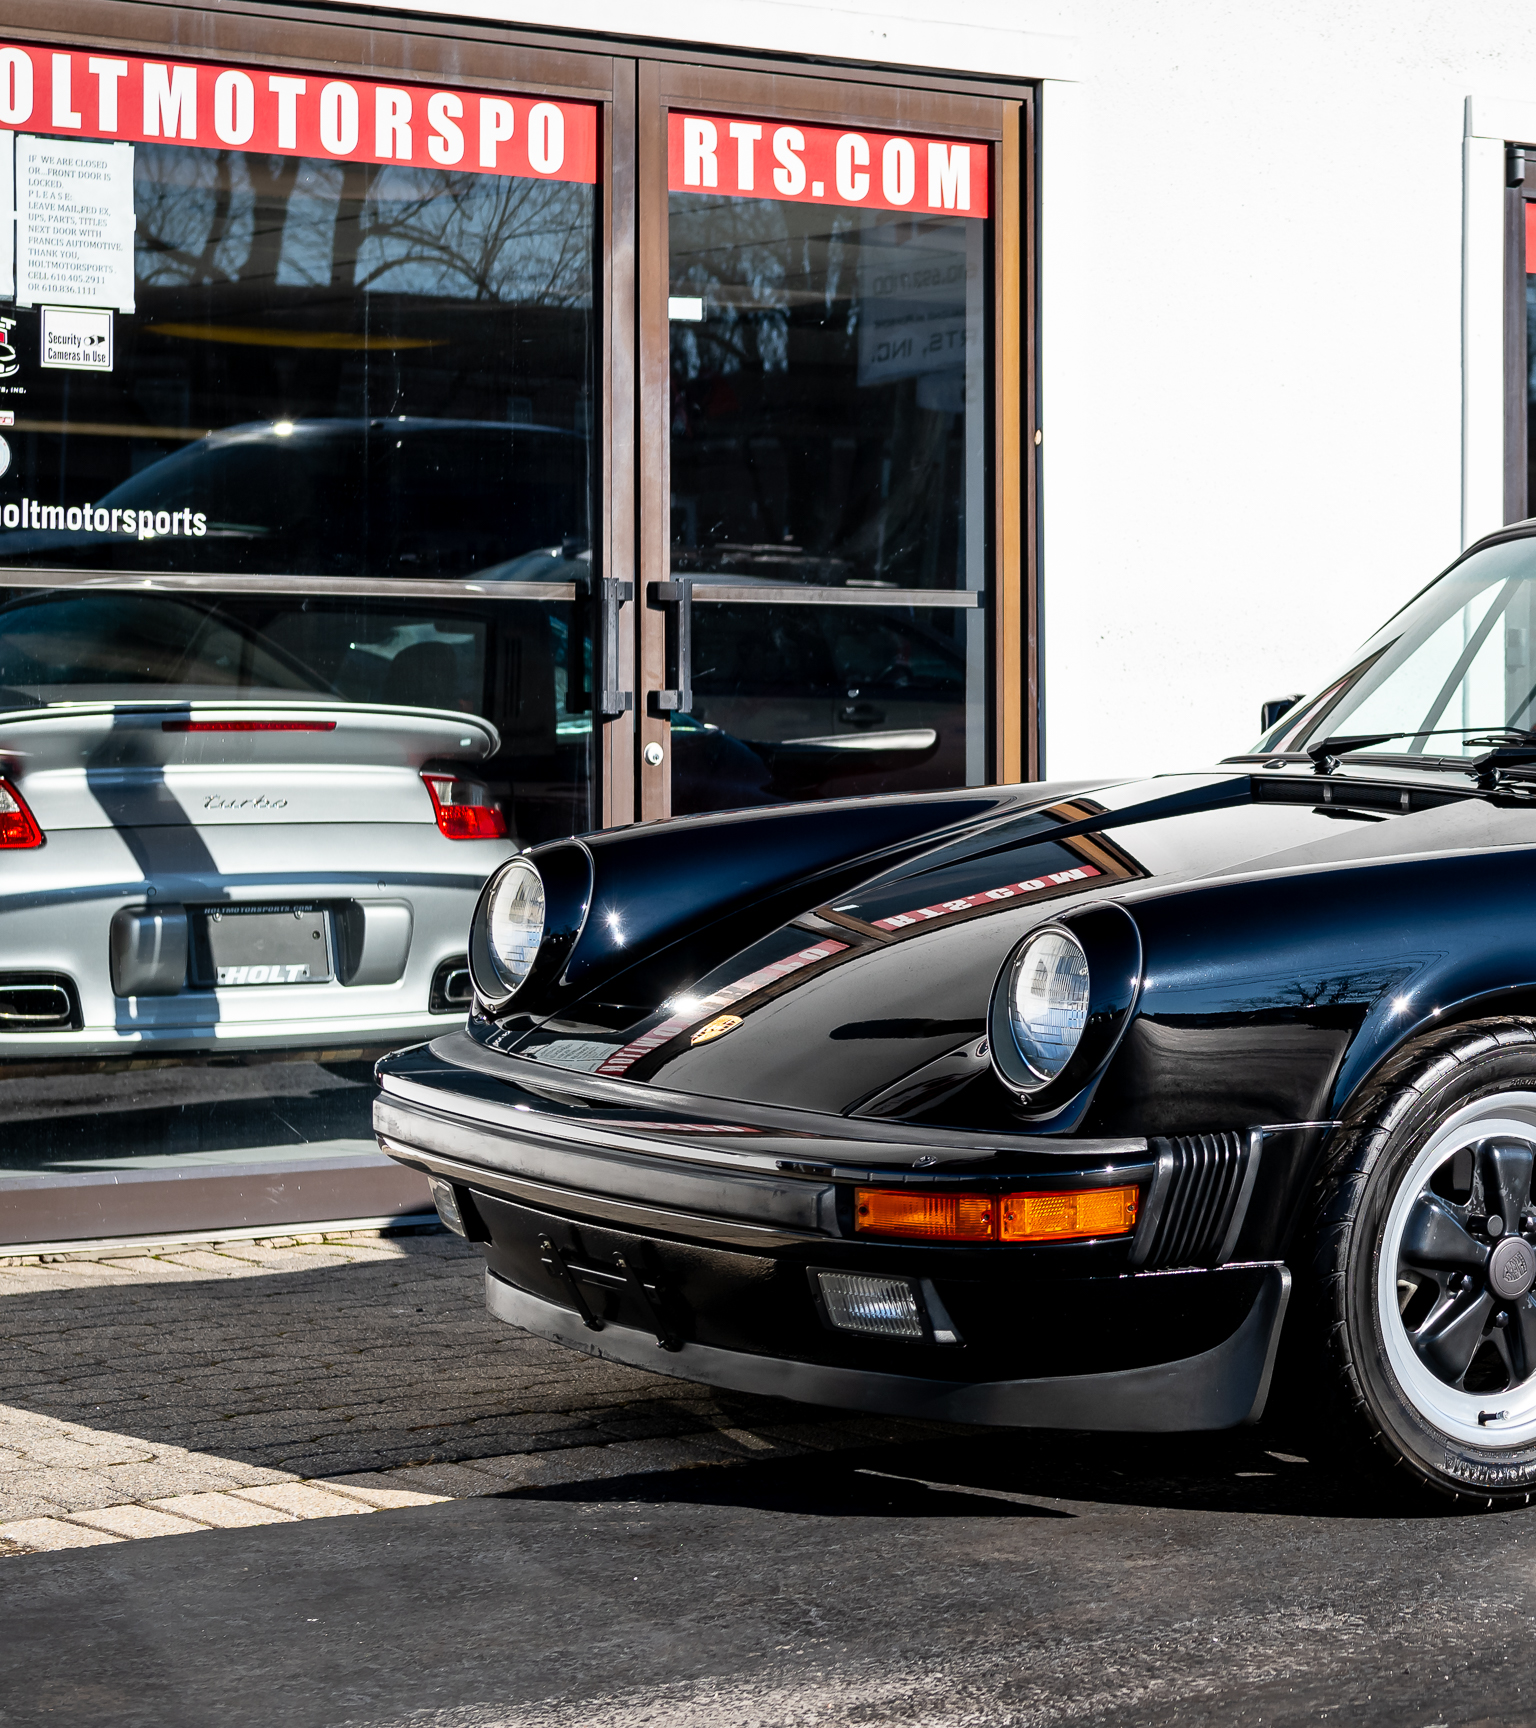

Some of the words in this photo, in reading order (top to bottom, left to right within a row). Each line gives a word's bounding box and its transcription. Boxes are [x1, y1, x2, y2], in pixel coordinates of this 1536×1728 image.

[0, 47, 565, 175] OLTMOTORSPO
[28, 154, 37, 163] IF
[41, 155, 55, 164] WE
[56, 157, 73, 166] ARE
[75, 159, 108, 169] CLOSED
[683, 117, 971, 211] RTS.COM
[78, 171, 102, 180] DOOR
[104, 173, 111, 181] IS
[28, 202, 56, 212] LEAVE
[48, 215, 77, 226] PARTS,
[79, 217, 108, 227] TITLES
[28, 225, 51, 234] NEXT
[53, 227, 77, 236] DOOR
[79, 229, 101, 238] WITH
[28, 237, 64, 247] FRANCIS
[28, 248, 58, 258] THANK
[28, 272, 49, 281] CELL
[48, 332, 81, 348] Security
[48, 348, 81, 361] Cameras
[83, 350, 90, 362] In
[93, 350, 106, 363] Use
[0, 497, 208, 541] oltmotorsports
[225, 964, 306, 985] HOLT
